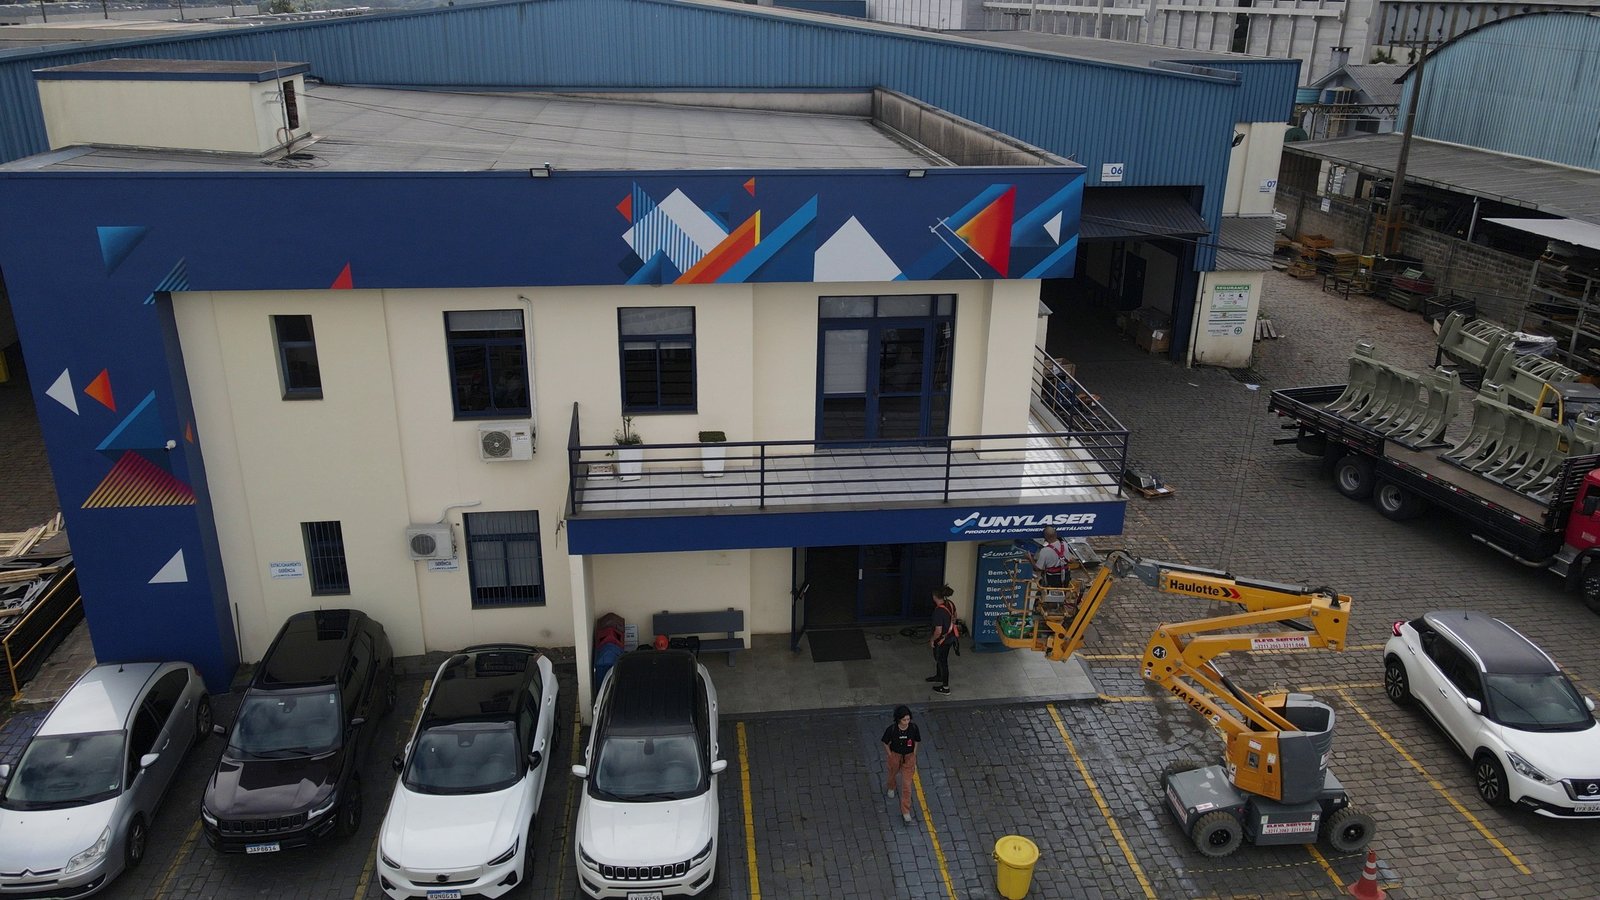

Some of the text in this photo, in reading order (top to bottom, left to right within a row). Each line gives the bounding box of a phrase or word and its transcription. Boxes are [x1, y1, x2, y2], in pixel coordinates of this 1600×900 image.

[1110, 166, 1123, 175] 06
[1267, 180, 1276, 188] 07
[977, 513, 1097, 528] UNYLASER
[1170, 579, 1220, 596] Haulotte
[1153, 648, 1167, 657] 41
[1171, 685, 1213, 716] HA12IP
